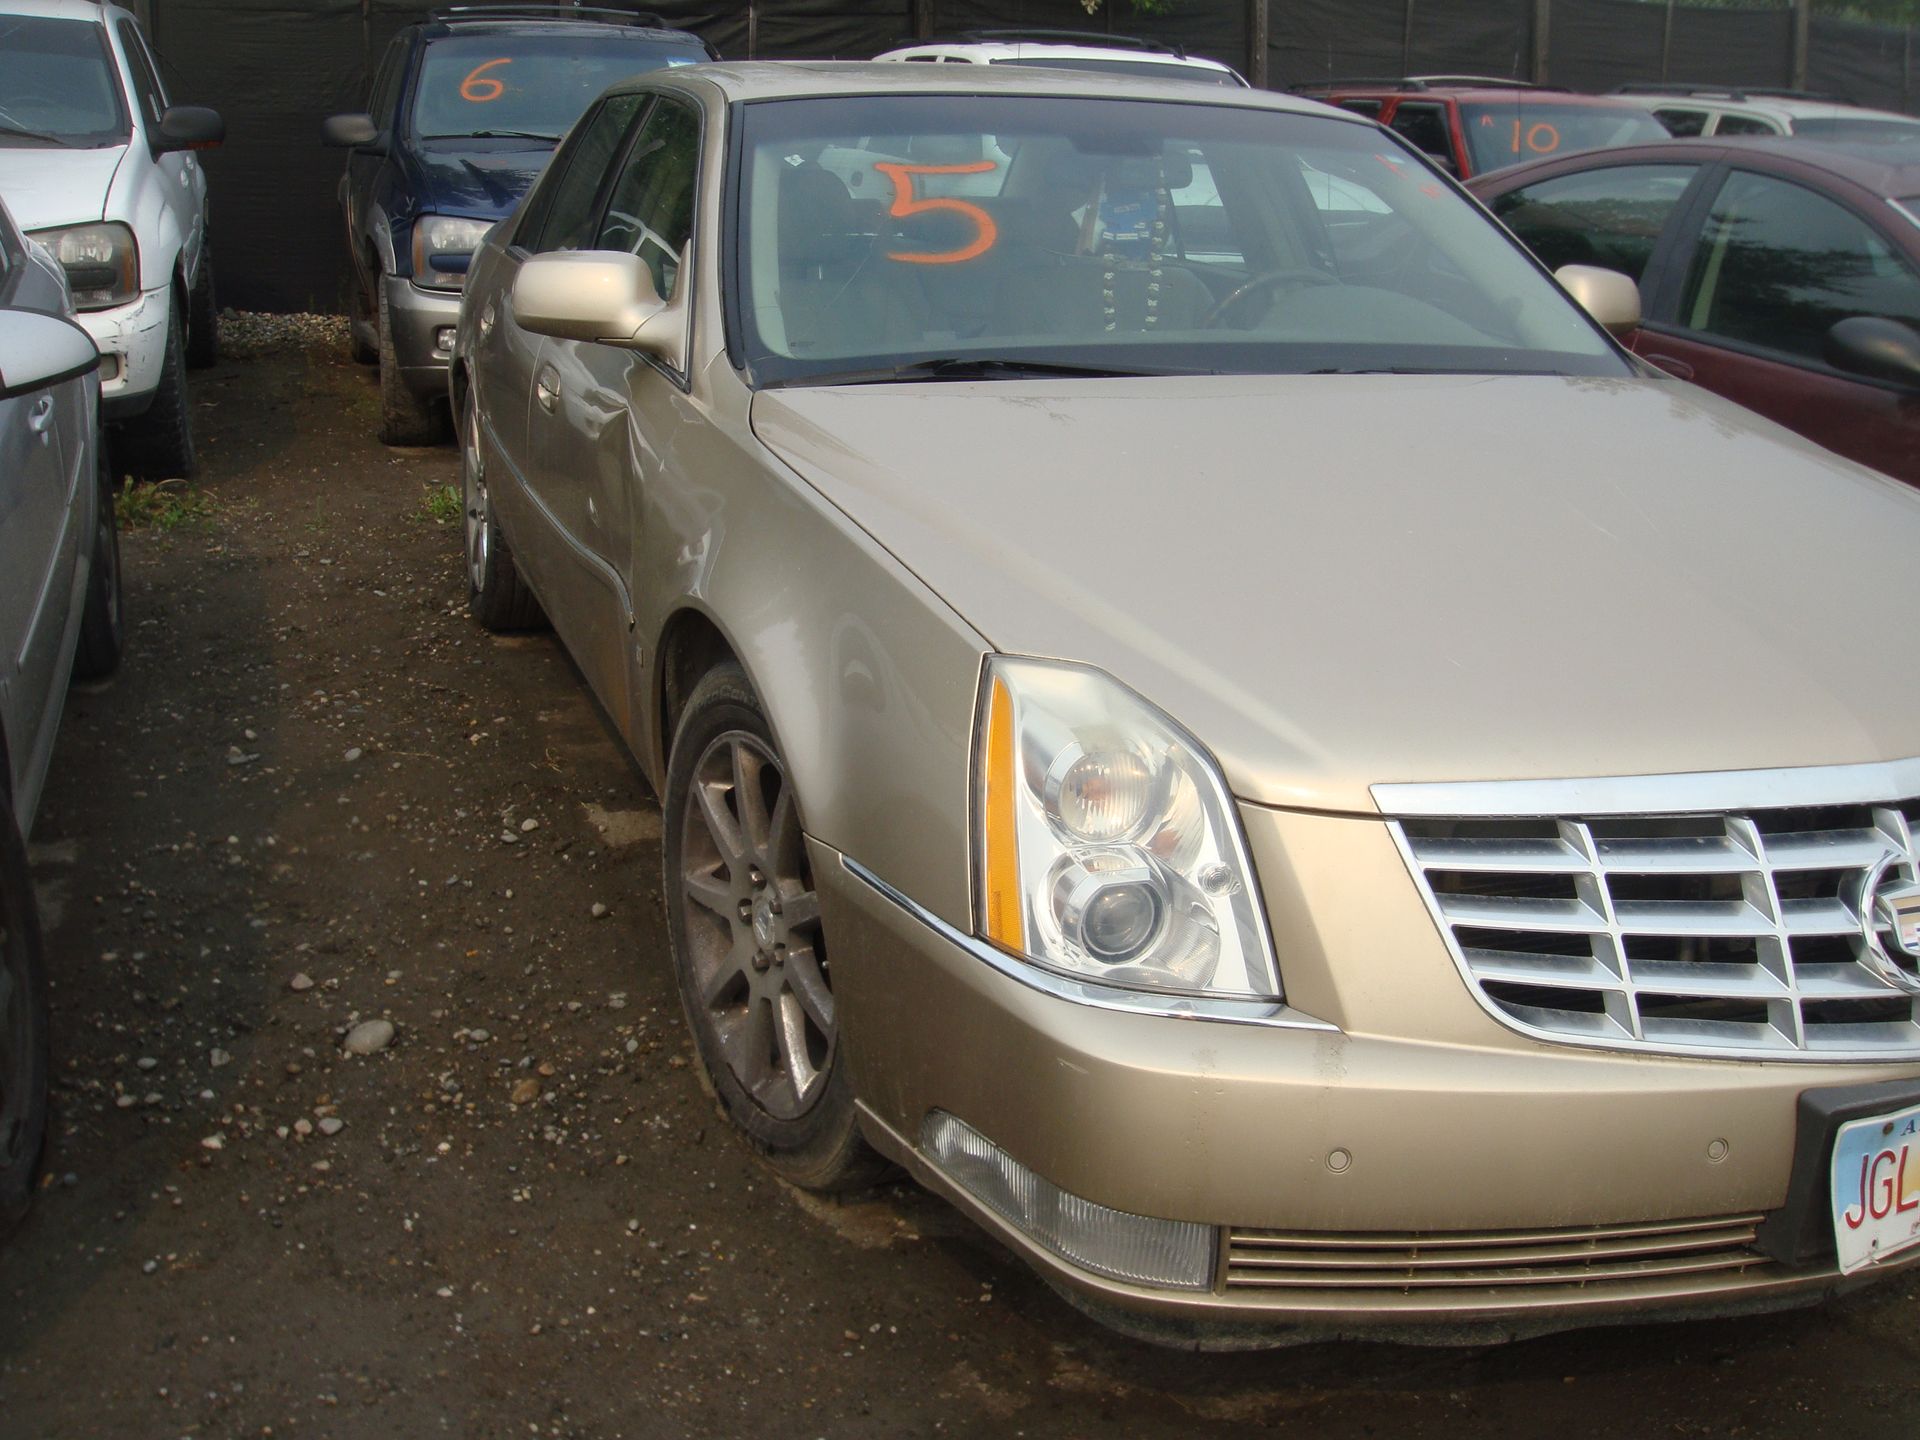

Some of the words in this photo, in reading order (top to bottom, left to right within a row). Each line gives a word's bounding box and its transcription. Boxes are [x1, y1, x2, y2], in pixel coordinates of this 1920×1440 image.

[460, 57, 512, 102] 6
[1511, 119, 1560, 152] 10
[874, 161, 997, 263] 5
[1845, 1145, 1919, 1229] JGL
